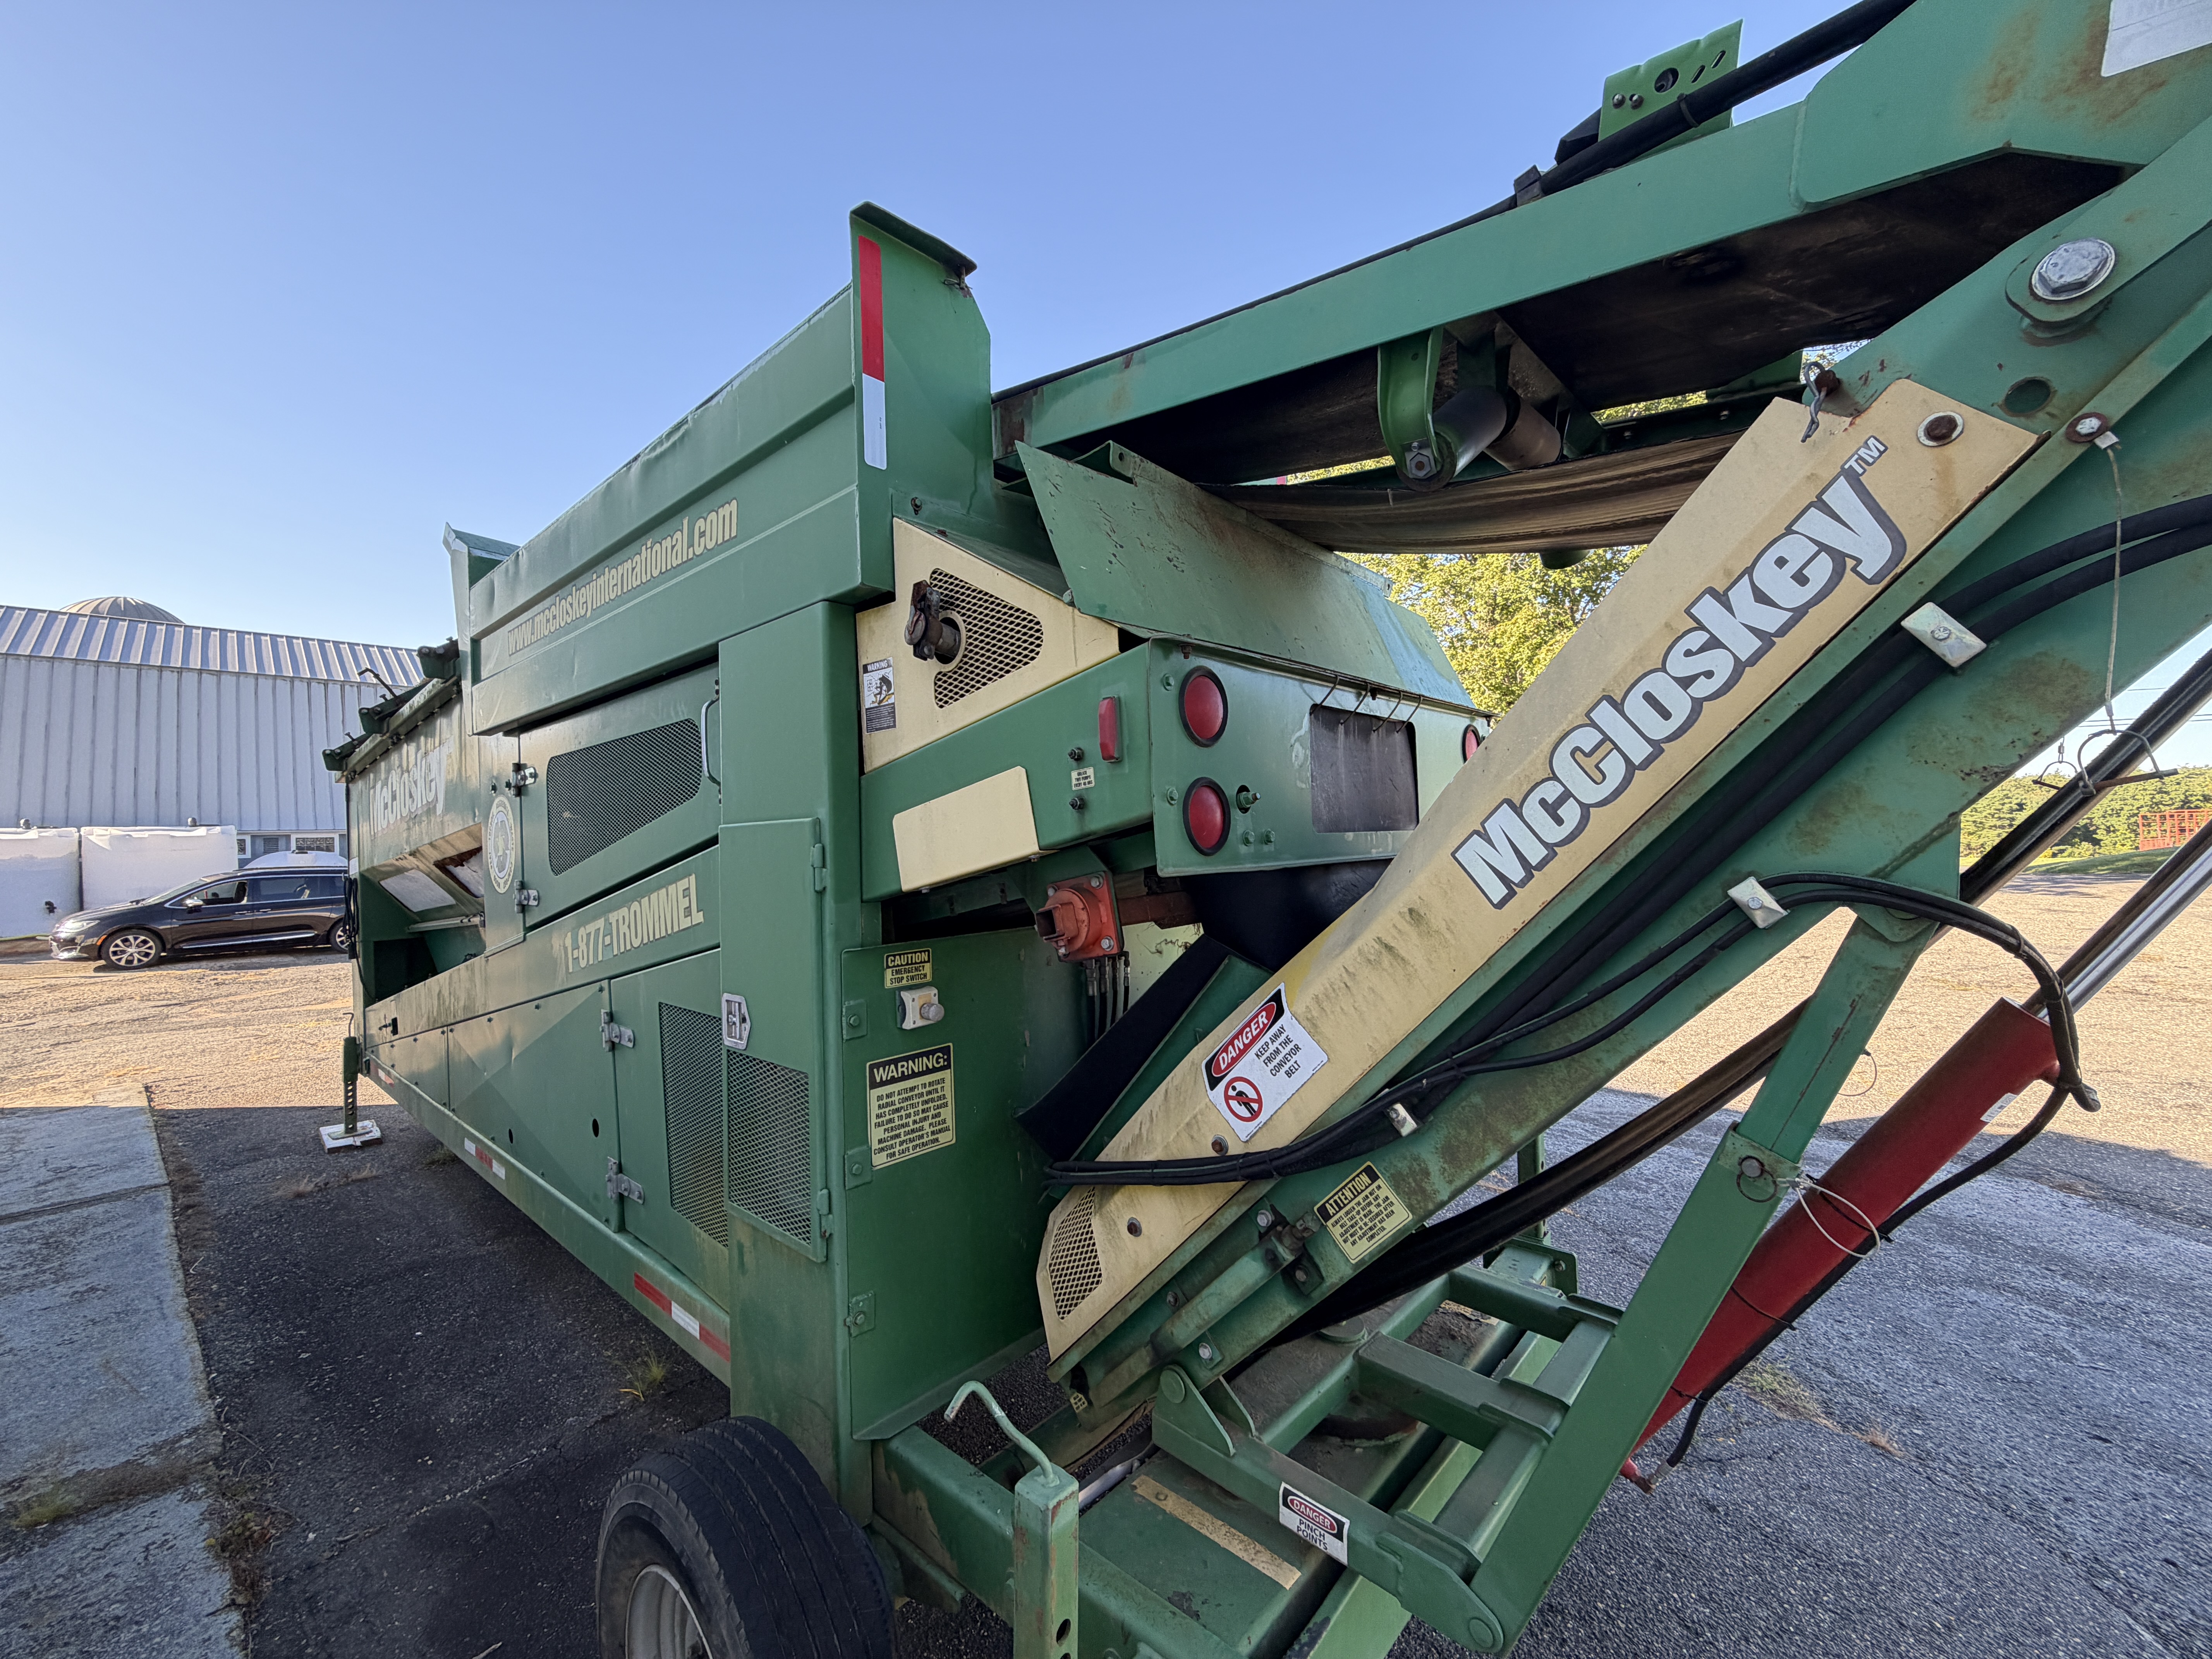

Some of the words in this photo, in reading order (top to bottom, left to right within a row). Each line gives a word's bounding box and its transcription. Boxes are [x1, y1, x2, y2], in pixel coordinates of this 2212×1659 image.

[507, 497, 738, 656] www.mccloskeyinternational.com
[867, 660, 888, 672] WARNING
[1451, 471, 1907, 909] McCloskey
[565, 873, 704, 973] 1-877-TROMMEL
[888, 951, 928, 967] CAUTION
[891, 965, 925, 976] EMERGENCY
[890, 976, 904, 985] STOP
[906, 972, 927, 982] SWITCH
[1219, 1011, 1269, 1070] DANGER
[1254, 1041, 1271, 1060] KEEP
[1271, 1024, 1286, 1045] AWAY
[1263, 1049, 1279, 1067] FROM
[1279, 1034, 1294, 1053] THE
[873, 1052, 948, 1083] WARNING:
[1269, 1043, 1302, 1077] CONVEYOR
[1284, 1060, 1301, 1079] BELT
[877, 1094, 884, 1102] DO
[885, 1091, 895, 1100] NOT
[897, 1084, 919, 1096] ATTEMPT
[928, 1077, 946, 1087] ROTATE
[878, 1099, 896, 1110] RADIAL
[898, 1091, 924, 1105] CONVEYOR
[926, 1087, 939, 1096] UNTIL
[874, 1116, 896, 1129] FAILURE
[905, 1112, 912, 1120] DO
[921, 1106, 932, 1115] MAY
[933, 1101, 949, 1111] CAUSE
[876, 1111, 886, 1120] HAS
[888, 1101, 920, 1116] COMPLETELY
[921, 1094, 947, 1106] UNFOLDED.
[878, 1132, 902, 1146] MACHINE
[903, 1125, 926, 1137] DAMAGE.
[929, 1118, 947, 1129] PLEASE
[883, 1121, 911, 1135] PERSONAL
[912, 1115, 930, 1126] INJURY
[931, 1111, 941, 1120] AND
[874, 1142, 897, 1155] CONSULT
[898, 1131, 929, 1147] OPERATOR'S
[931, 1125, 951, 1137] MANUAL
[886, 1151, 896, 1160] FOR
[898, 1146, 910, 1156] SAFE
[912, 1137, 941, 1151] OPERATION.
[1325, 1172, 1372, 1216] ATTENTION
[1331, 1215, 1344, 1228] ALWAYS
[1354, 1200, 1362, 1208] THE
[1362, 1194, 1370, 1203] JAM
[1368, 1188, 1376, 1197] NUT
[1383, 1200, 1395, 1212] AFTER
[1339, 1220, 1348, 1230] BELT
[1346, 1209, 1361, 1223] TAKE-UP
[1360, 1200, 1374, 1212] BEFORE
[1372, 1194, 1381, 1203] ANY
[1339, 1219, 1360, 1238] ADJUSTMENT
[1374, 1202, 1382, 1210] THE
[1381, 1195, 1390, 1204] JAM
[1357, 1222, 1379, 1242] ADJUSTMENT
[1377, 1216, 1386, 1225] HAS
[1384, 1209, 1395, 1219] BEEN
[1366, 1225, 1387, 1243] COMPLETED.
[1293, 1500, 1331, 1529] DANGER
[1297, 1525, 1328, 1551] POINTS
[1299, 1518, 1325, 1541] PINCH
